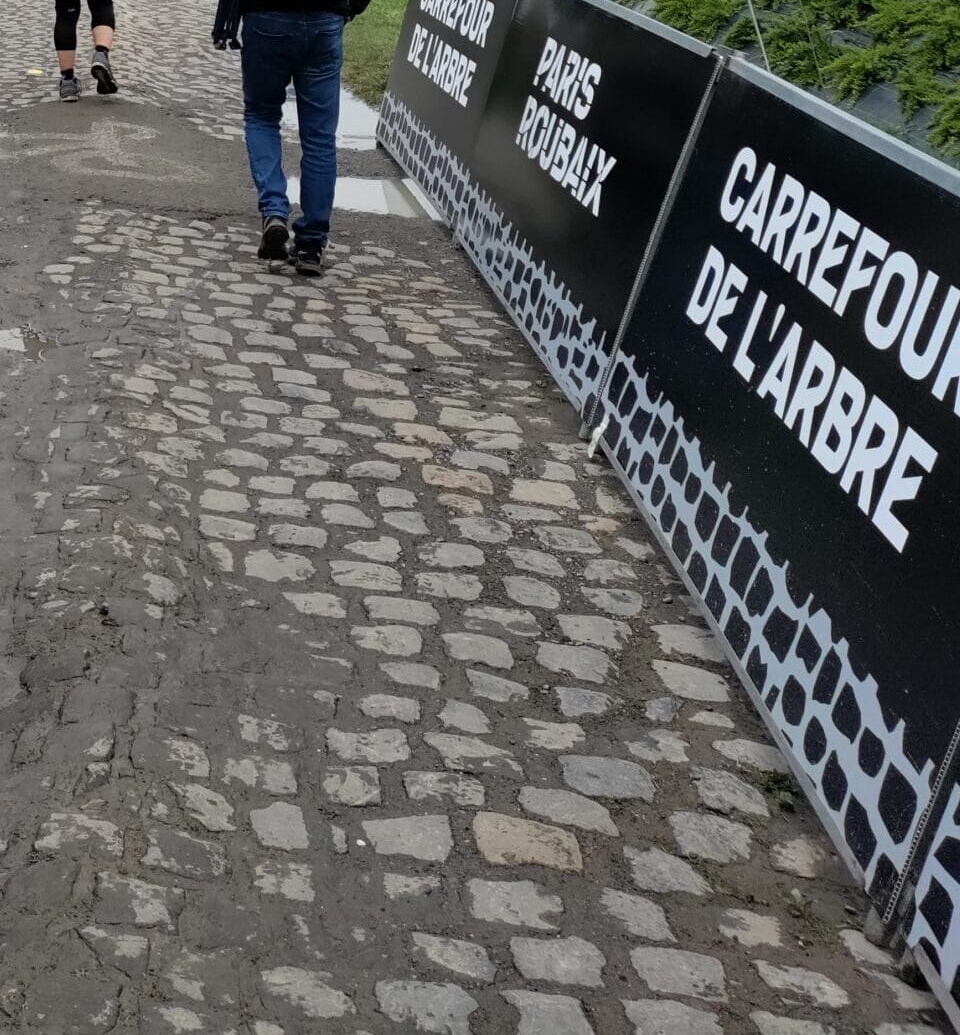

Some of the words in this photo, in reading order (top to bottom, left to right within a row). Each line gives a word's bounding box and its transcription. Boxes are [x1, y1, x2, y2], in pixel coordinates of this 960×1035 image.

[406, 22, 429, 70] DE
[421, 32, 477, 108] L'ARBRE
[533, 36, 602, 121] PARIS
[515, 95, 617, 218] ROUBAIX
[686, 244, 749, 353] DE
[732, 290, 938, 554] L'ARBRE
